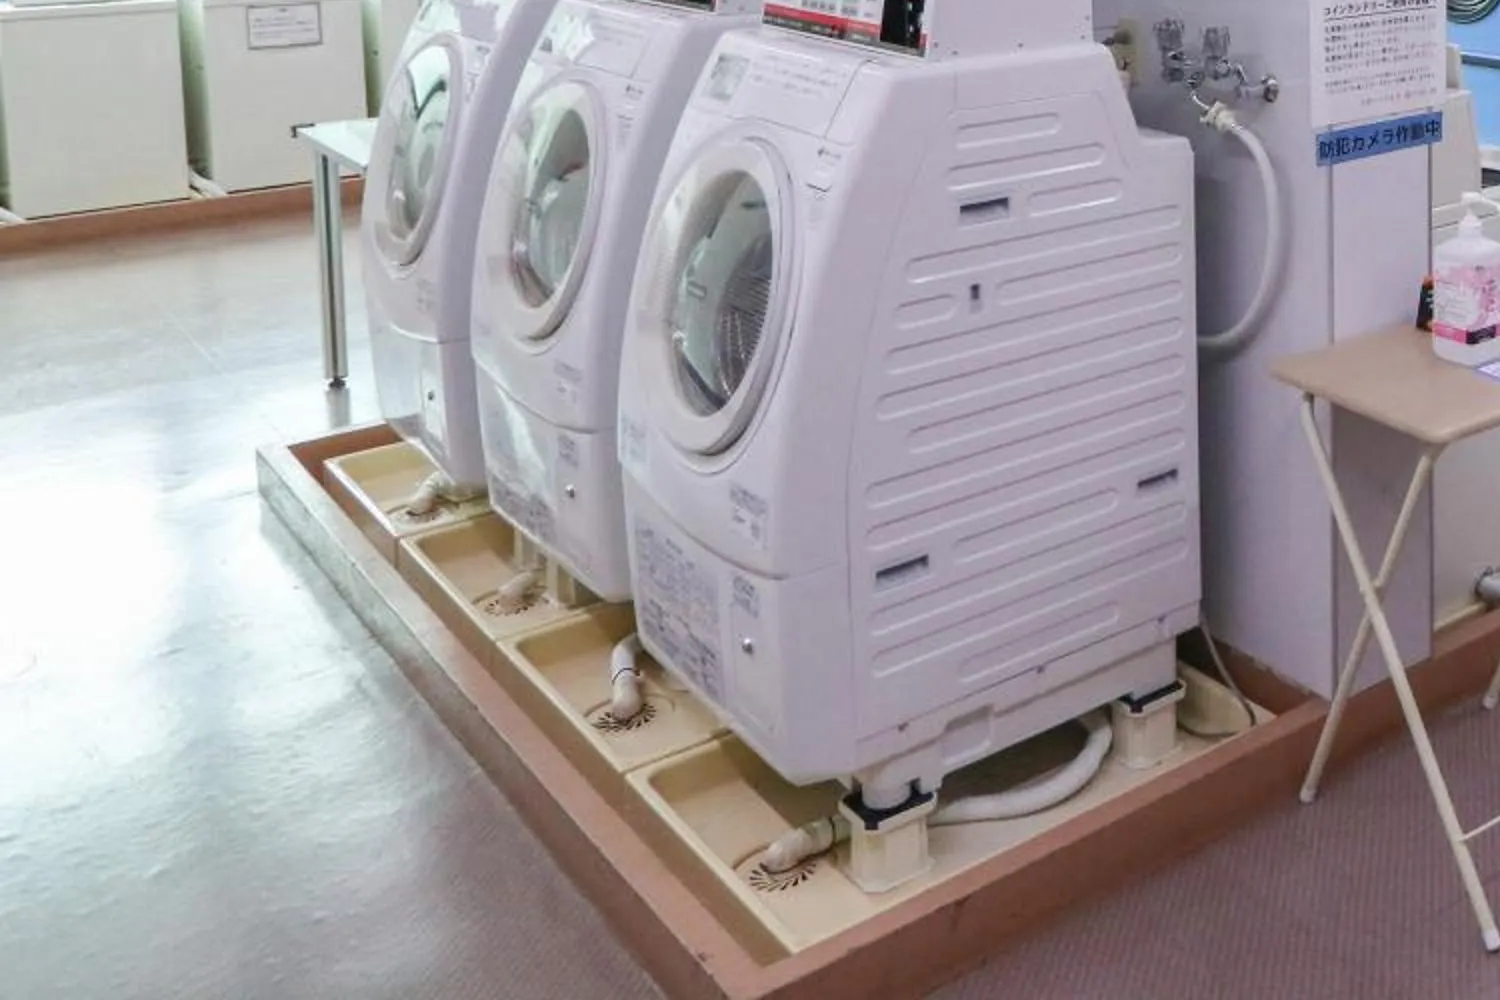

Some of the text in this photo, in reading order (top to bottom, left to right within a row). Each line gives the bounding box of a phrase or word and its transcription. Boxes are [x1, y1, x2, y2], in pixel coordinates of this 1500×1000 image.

[1318, 119, 1441, 160] 防犯カメラ作動中
